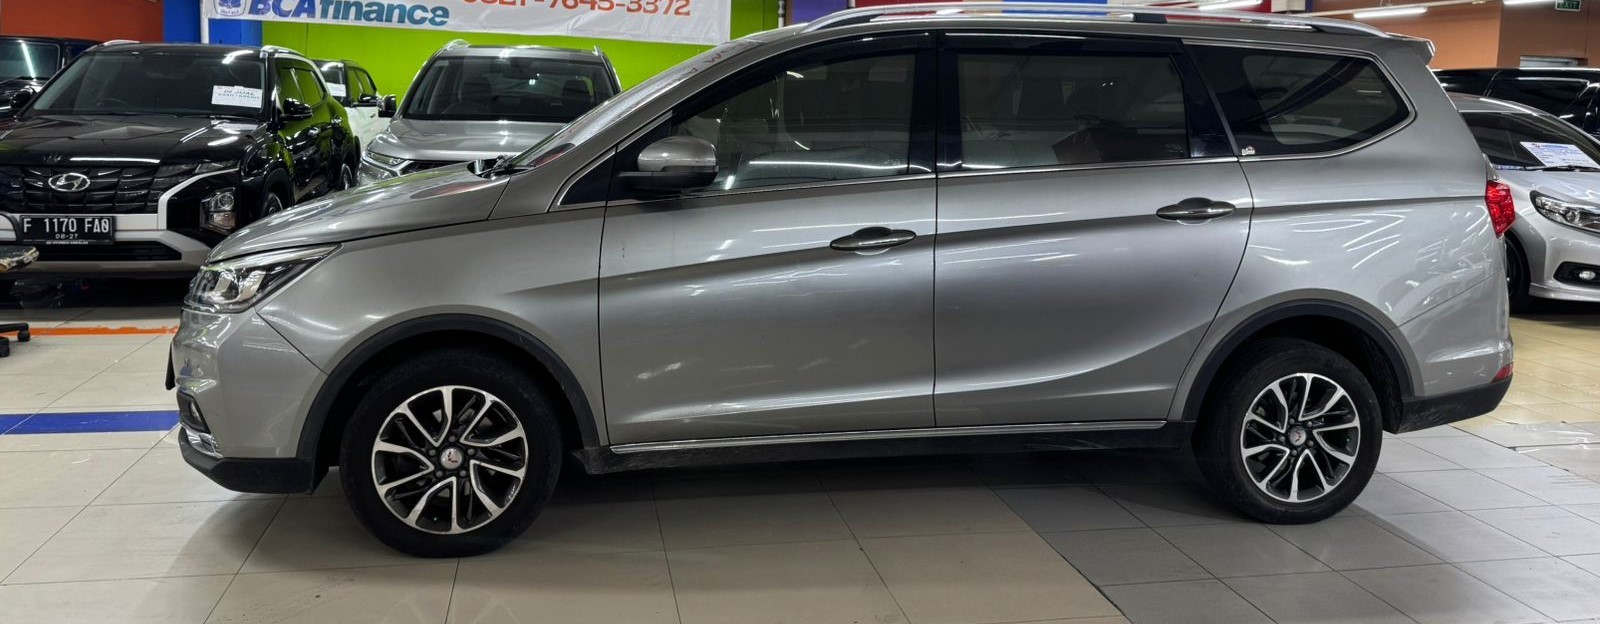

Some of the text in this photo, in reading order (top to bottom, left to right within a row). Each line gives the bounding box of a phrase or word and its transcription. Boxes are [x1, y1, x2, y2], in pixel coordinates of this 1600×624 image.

[463, 0, 691, 16] -645-3372
[1559, 1, 1578, 9] EXIT
[23, 218, 32, 233] F
[44, 218, 77, 233] 1170
